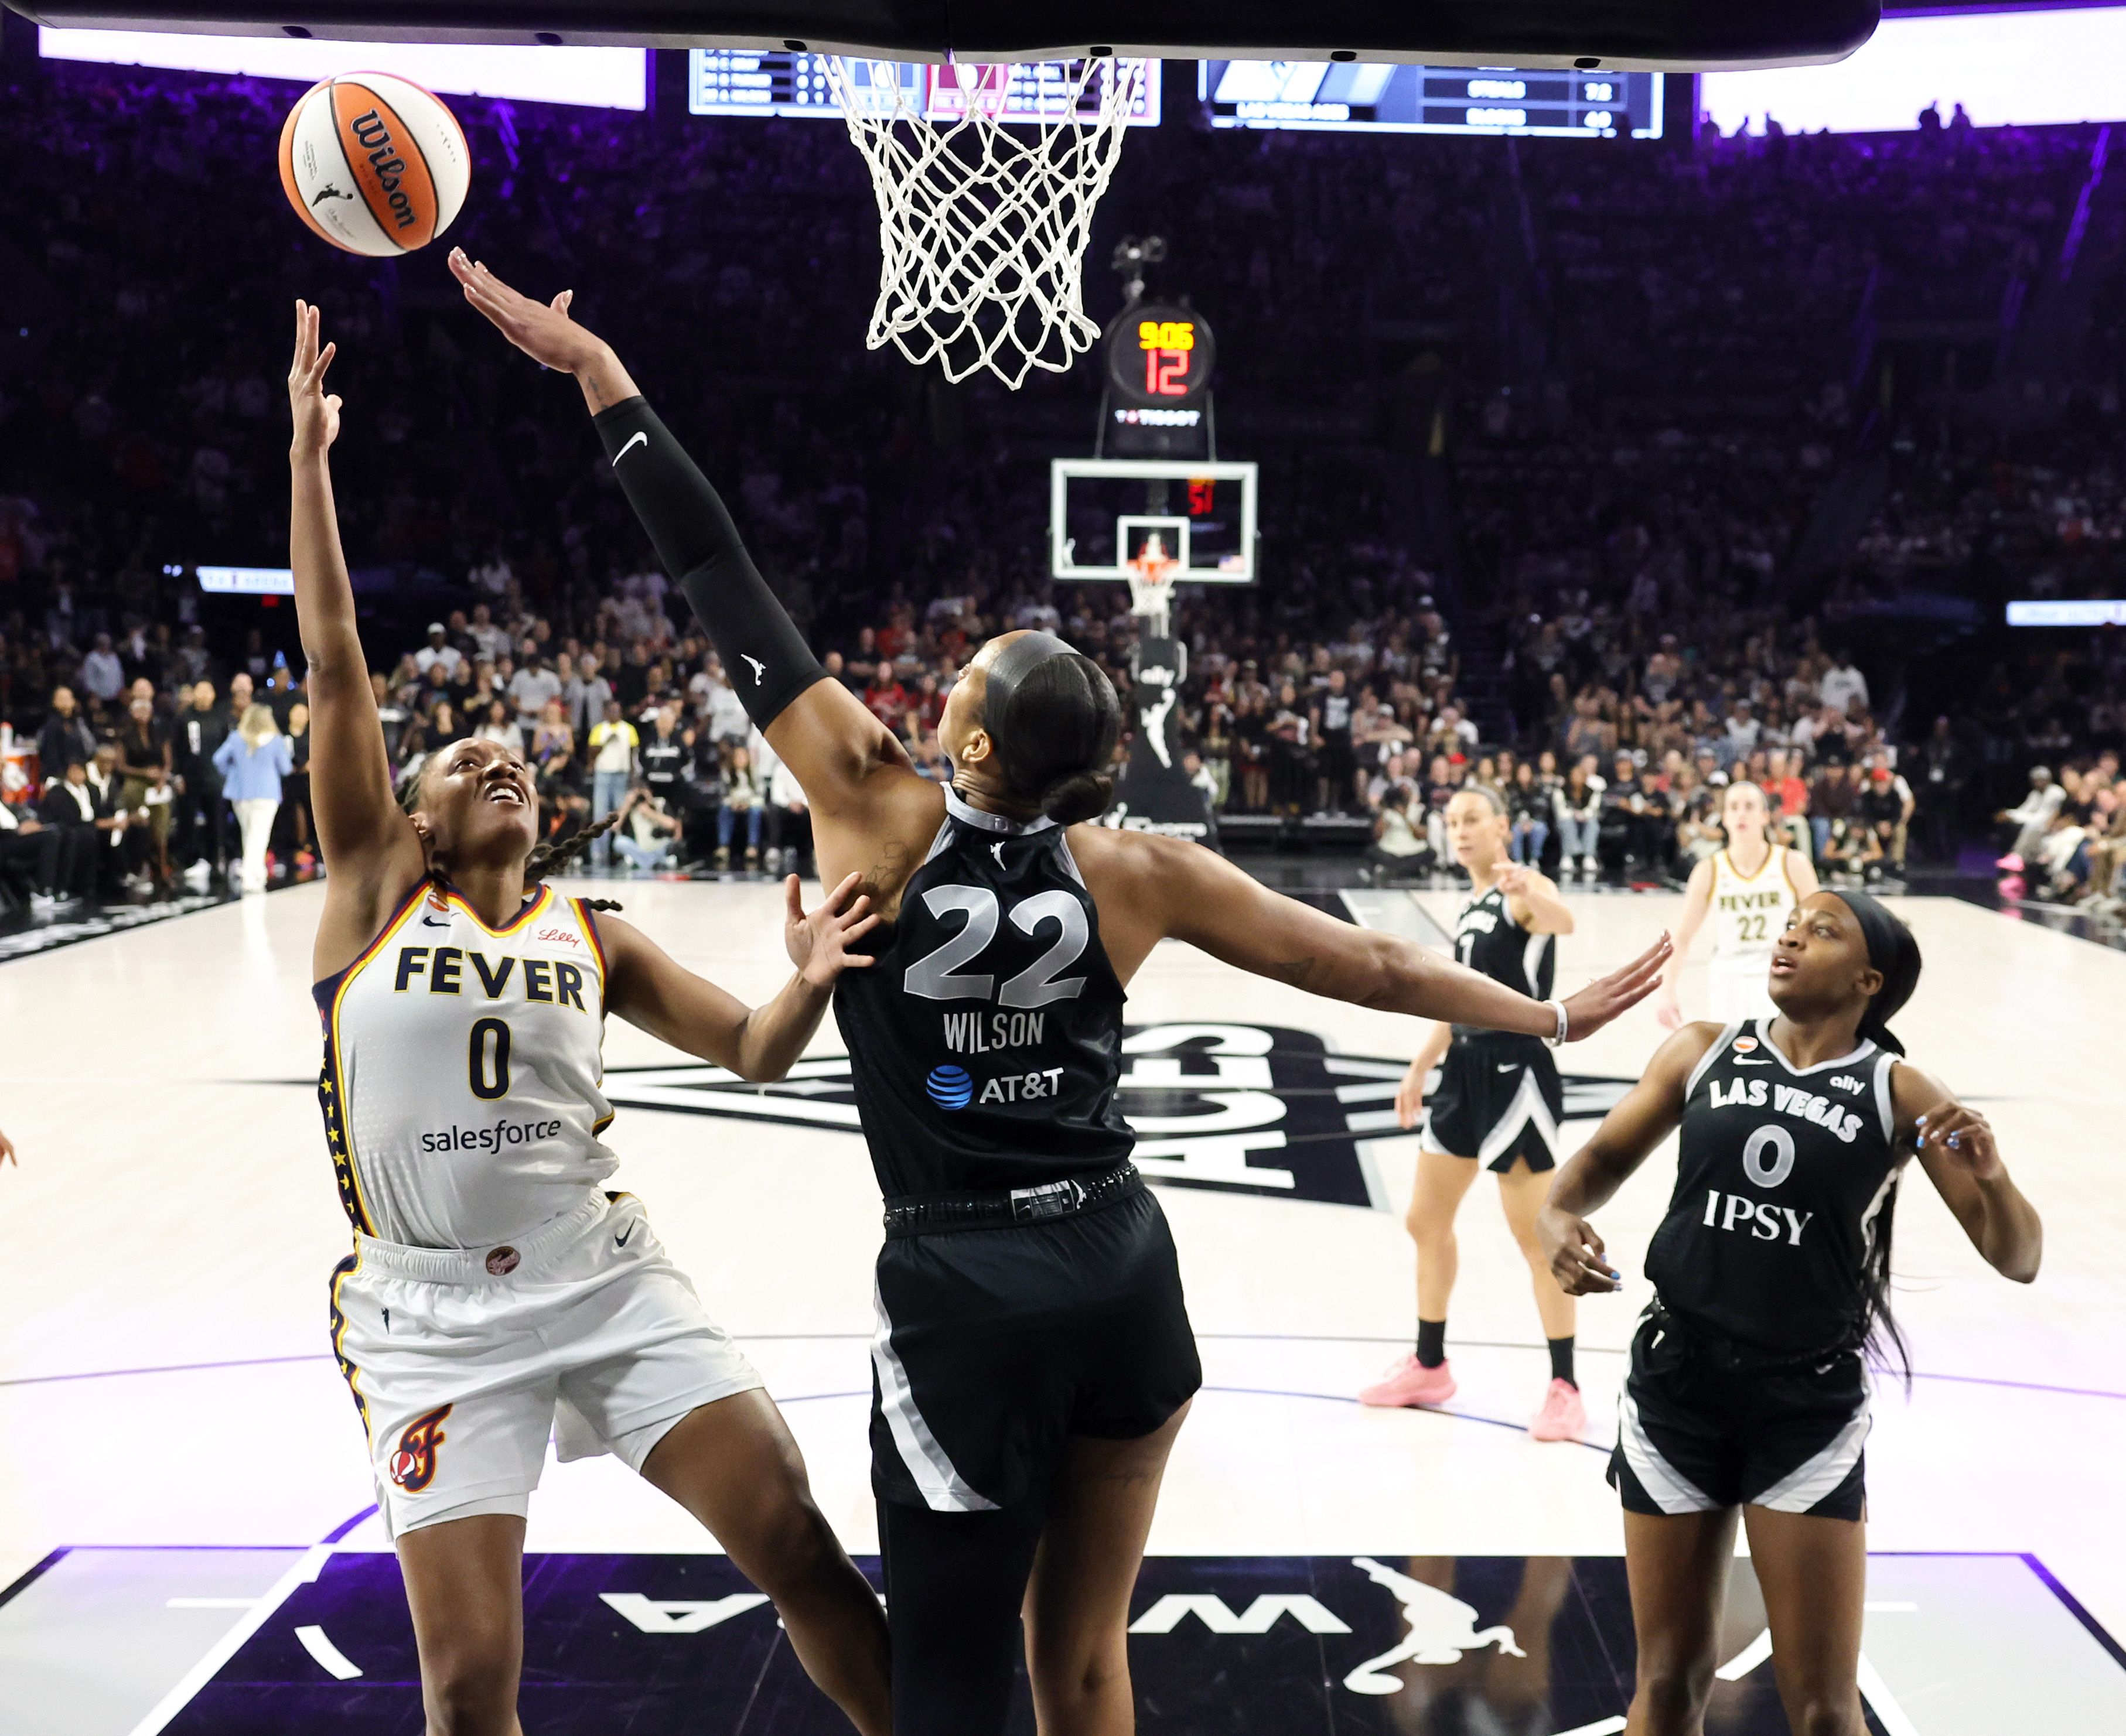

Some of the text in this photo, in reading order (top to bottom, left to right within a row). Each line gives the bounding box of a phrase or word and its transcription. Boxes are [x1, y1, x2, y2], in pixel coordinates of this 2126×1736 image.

[350, 108, 417, 230] Wilson
[1146, 348, 1189, 395] 12
[1719, 891, 1781, 910] FEVER
[537, 929, 581, 948] Lilly
[903, 884, 1089, 1009] 22
[1738, 914, 1767, 941] 22
[394, 946, 588, 1014] FEVER
[942, 1011, 1045, 1054] WILSON
[468, 1016, 511, 1102] 0
[979, 1067, 1064, 1104] AT&T
[1829, 1075, 1866, 1095] ally
[1709, 1077, 1864, 1143] LAS VEGAS
[422, 1119, 561, 1154] salesforce
[1743, 1124, 1795, 1188] 0
[1702, 1190, 1813, 1246] IPSY
